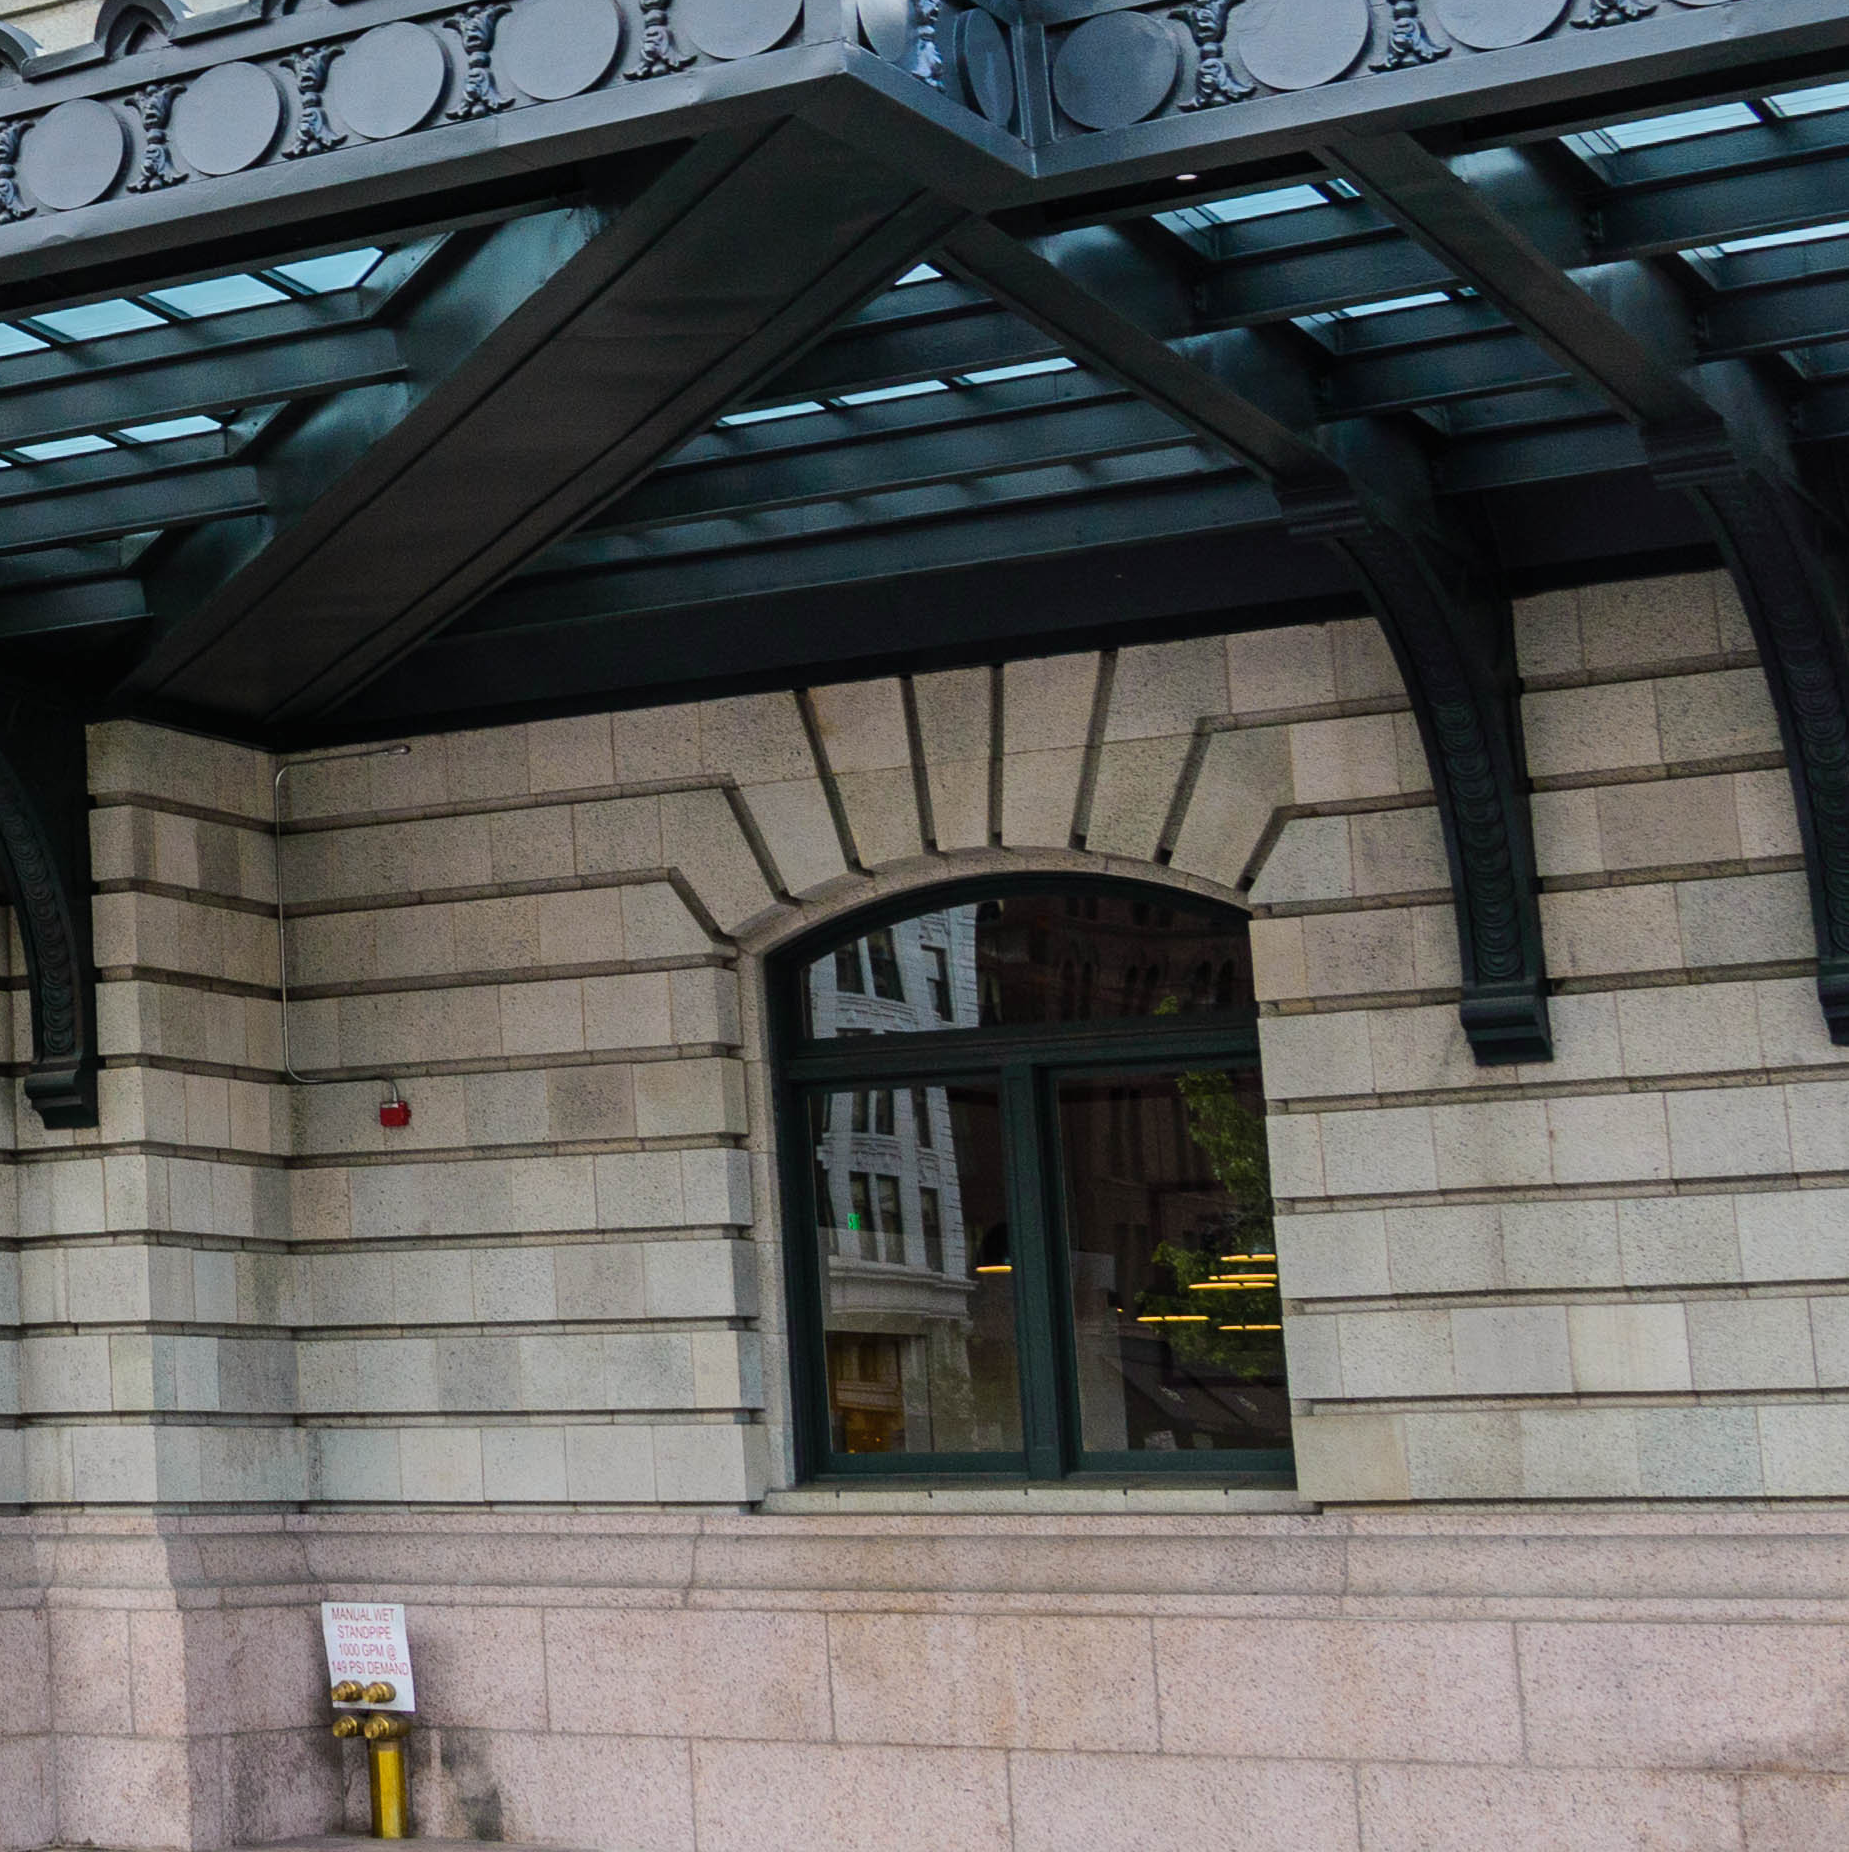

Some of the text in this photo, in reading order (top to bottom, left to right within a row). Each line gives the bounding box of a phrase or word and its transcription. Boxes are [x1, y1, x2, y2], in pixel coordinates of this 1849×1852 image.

[331, 1607, 395, 1622] MANUAL WET
[337, 1624, 393, 1640] STANDPIPE
[362, 1643, 385, 1657] GPM
[349, 1660, 365, 1675] PSI
[367, 1661, 409, 1676] DEMAND
